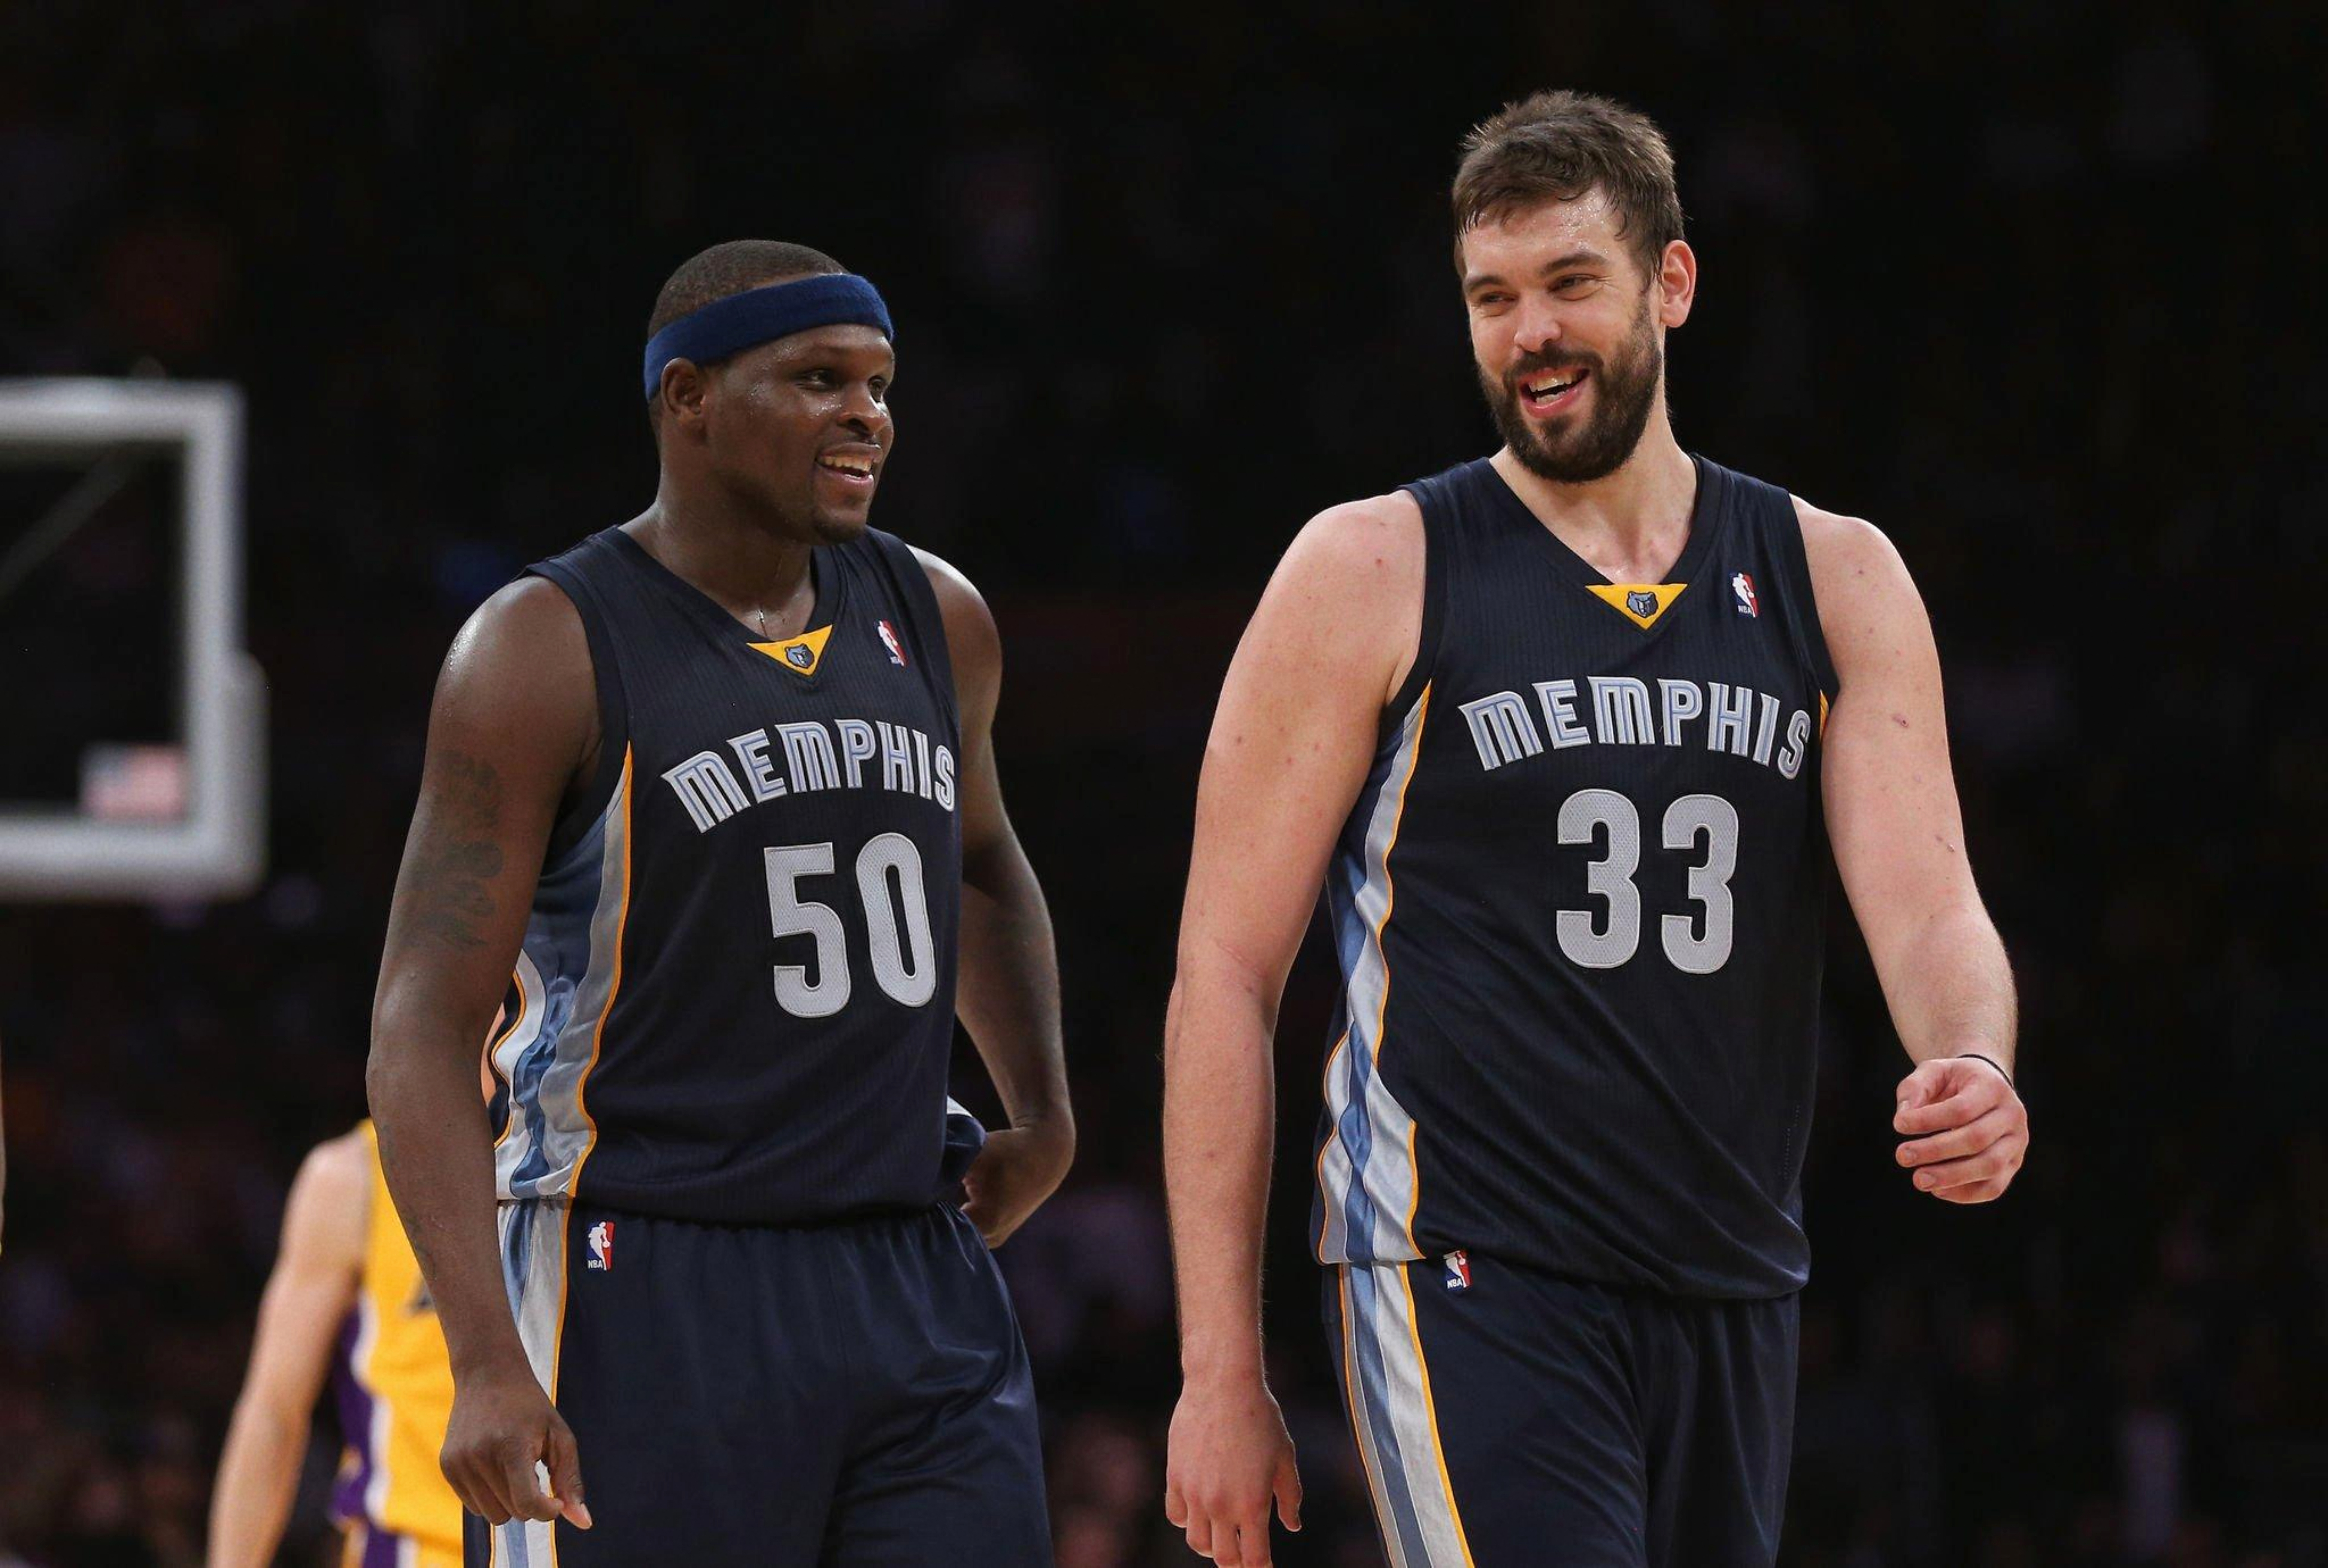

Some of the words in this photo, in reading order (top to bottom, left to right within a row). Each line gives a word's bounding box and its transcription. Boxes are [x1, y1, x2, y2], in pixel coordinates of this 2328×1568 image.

[662, 719, 954, 833] MEMPHIS
[1458, 676, 1810, 780] MEMPHIS
[764, 832, 936, 1018] 50
[1556, 788, 1739, 974] 33
[587, 1260, 603, 1269] NBA
[1447, 1278, 1463, 1289] NBA
